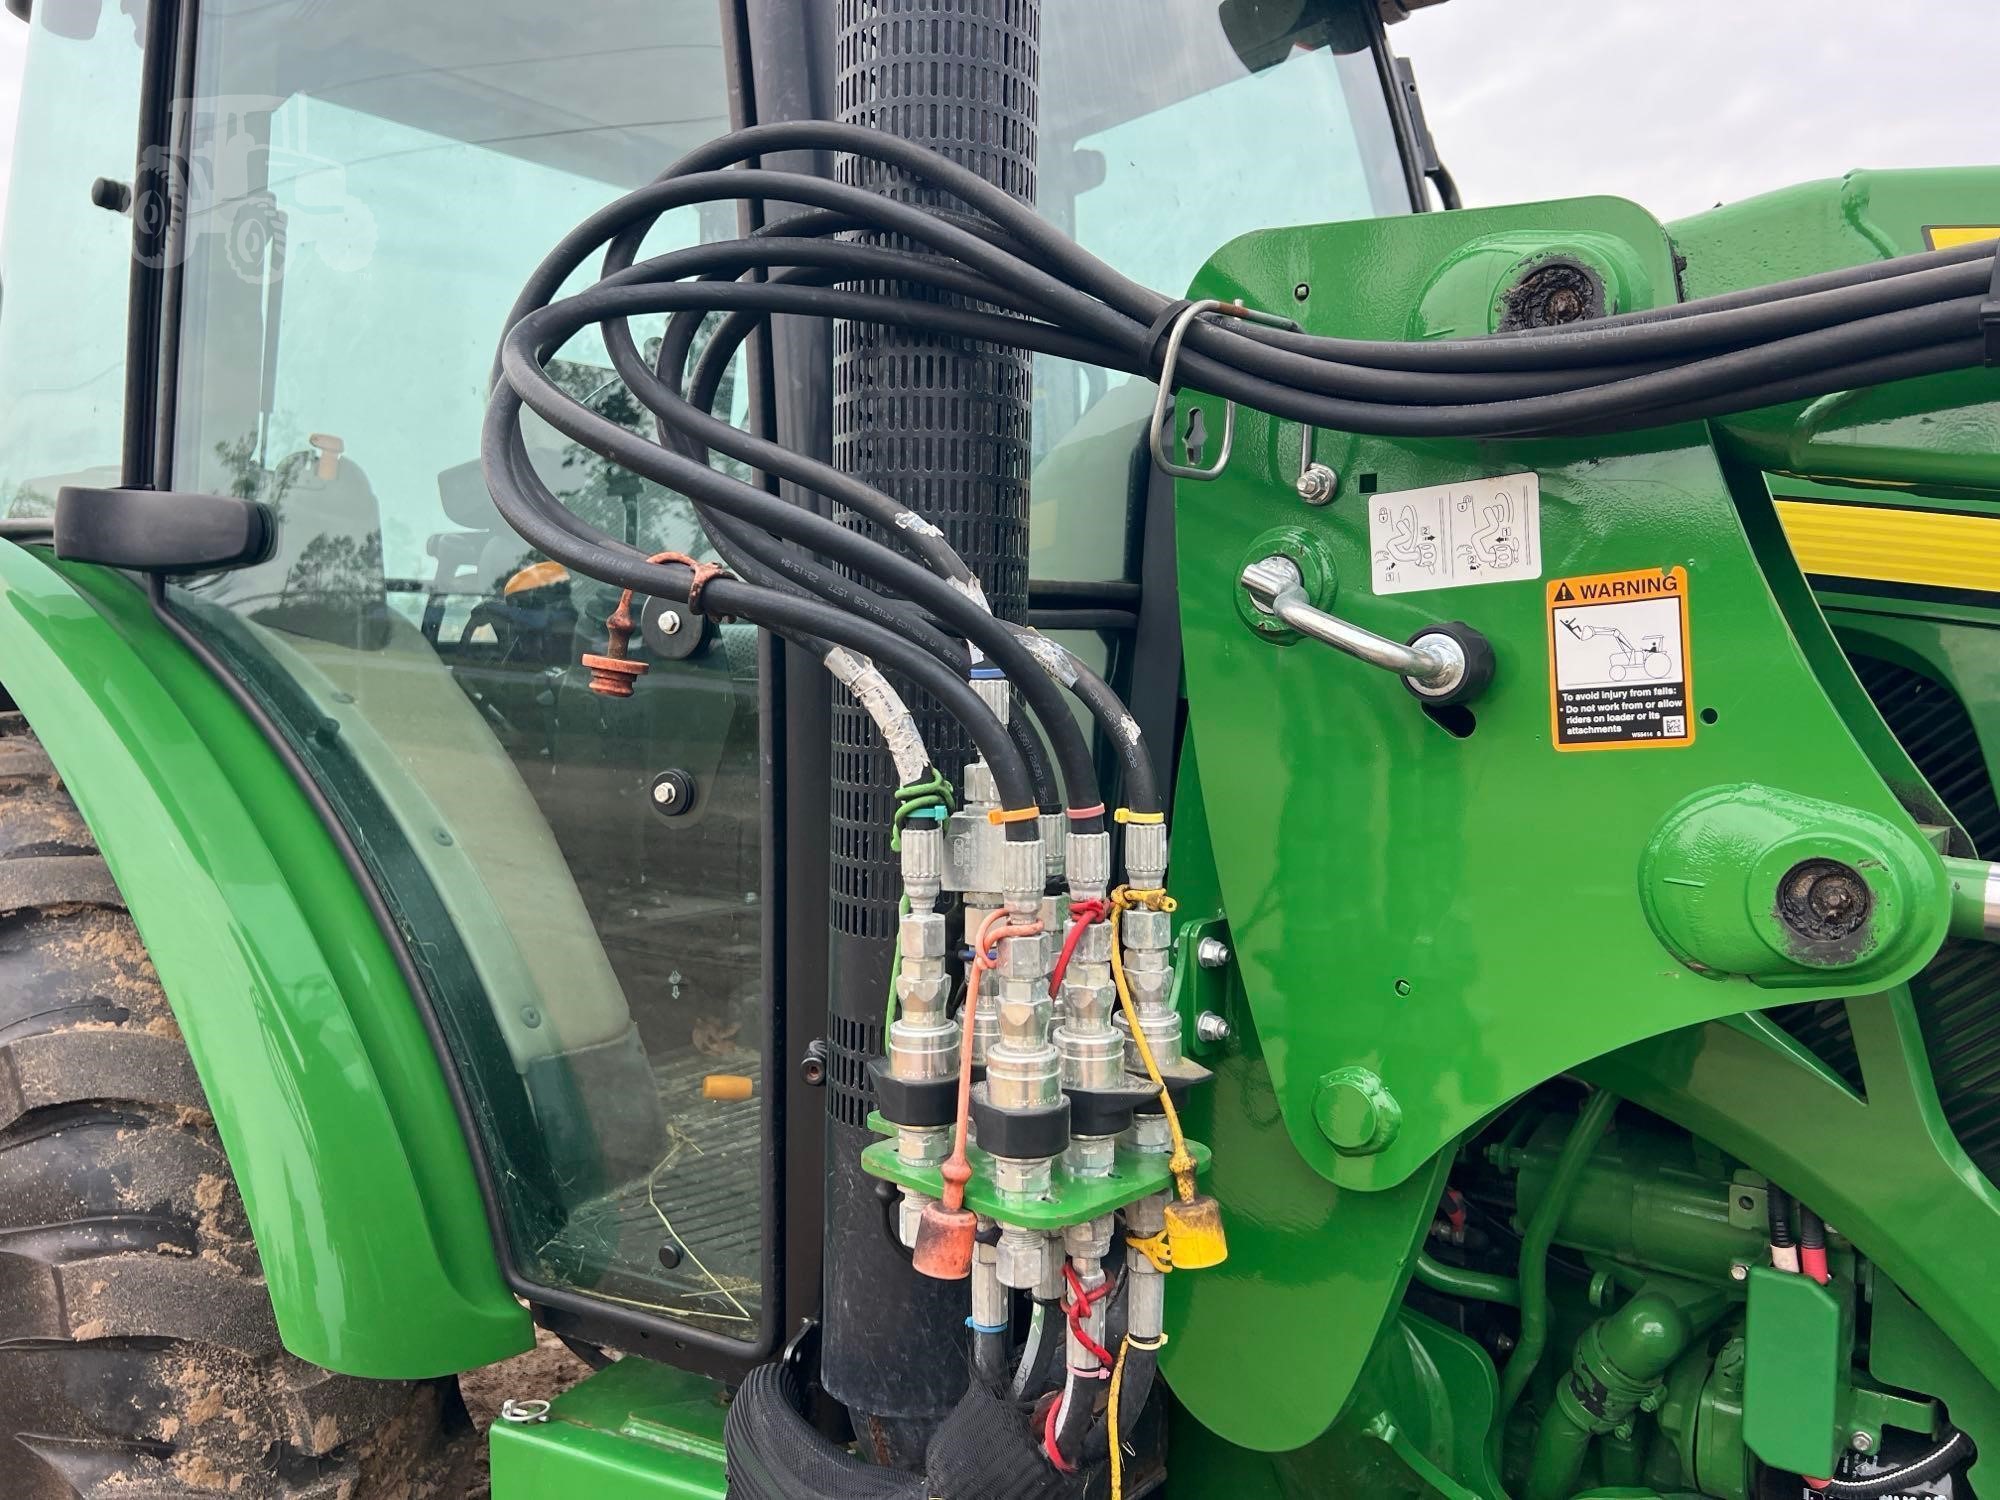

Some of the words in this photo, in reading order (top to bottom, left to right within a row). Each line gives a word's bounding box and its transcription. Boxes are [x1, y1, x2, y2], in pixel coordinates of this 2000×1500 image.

[1580, 576, 1677, 599] WARNING
[1562, 692, 1573, 702] To
[1575, 691, 1599, 701] avoid
[1601, 689, 1627, 700] injury
[1630, 688, 1651, 697] from
[1654, 687, 1676, 696] falls:
[1566, 705, 1578, 714] Do
[1580, 703, 1595, 713] not
[1597, 702, 1620, 712] work
[1622, 701, 1644, 711] from
[1646, 701, 1655, 709] or
[1658, 699, 1682, 708] allow
[1566, 715, 1592, 724] riders
[1593, 715, 1605, 723] on
[1607, 713, 1635, 722] loader
[1637, 713, 1646, 721] or
[1648, 711, 1660, 719] its
[1567, 725, 1622, 735] attachments
